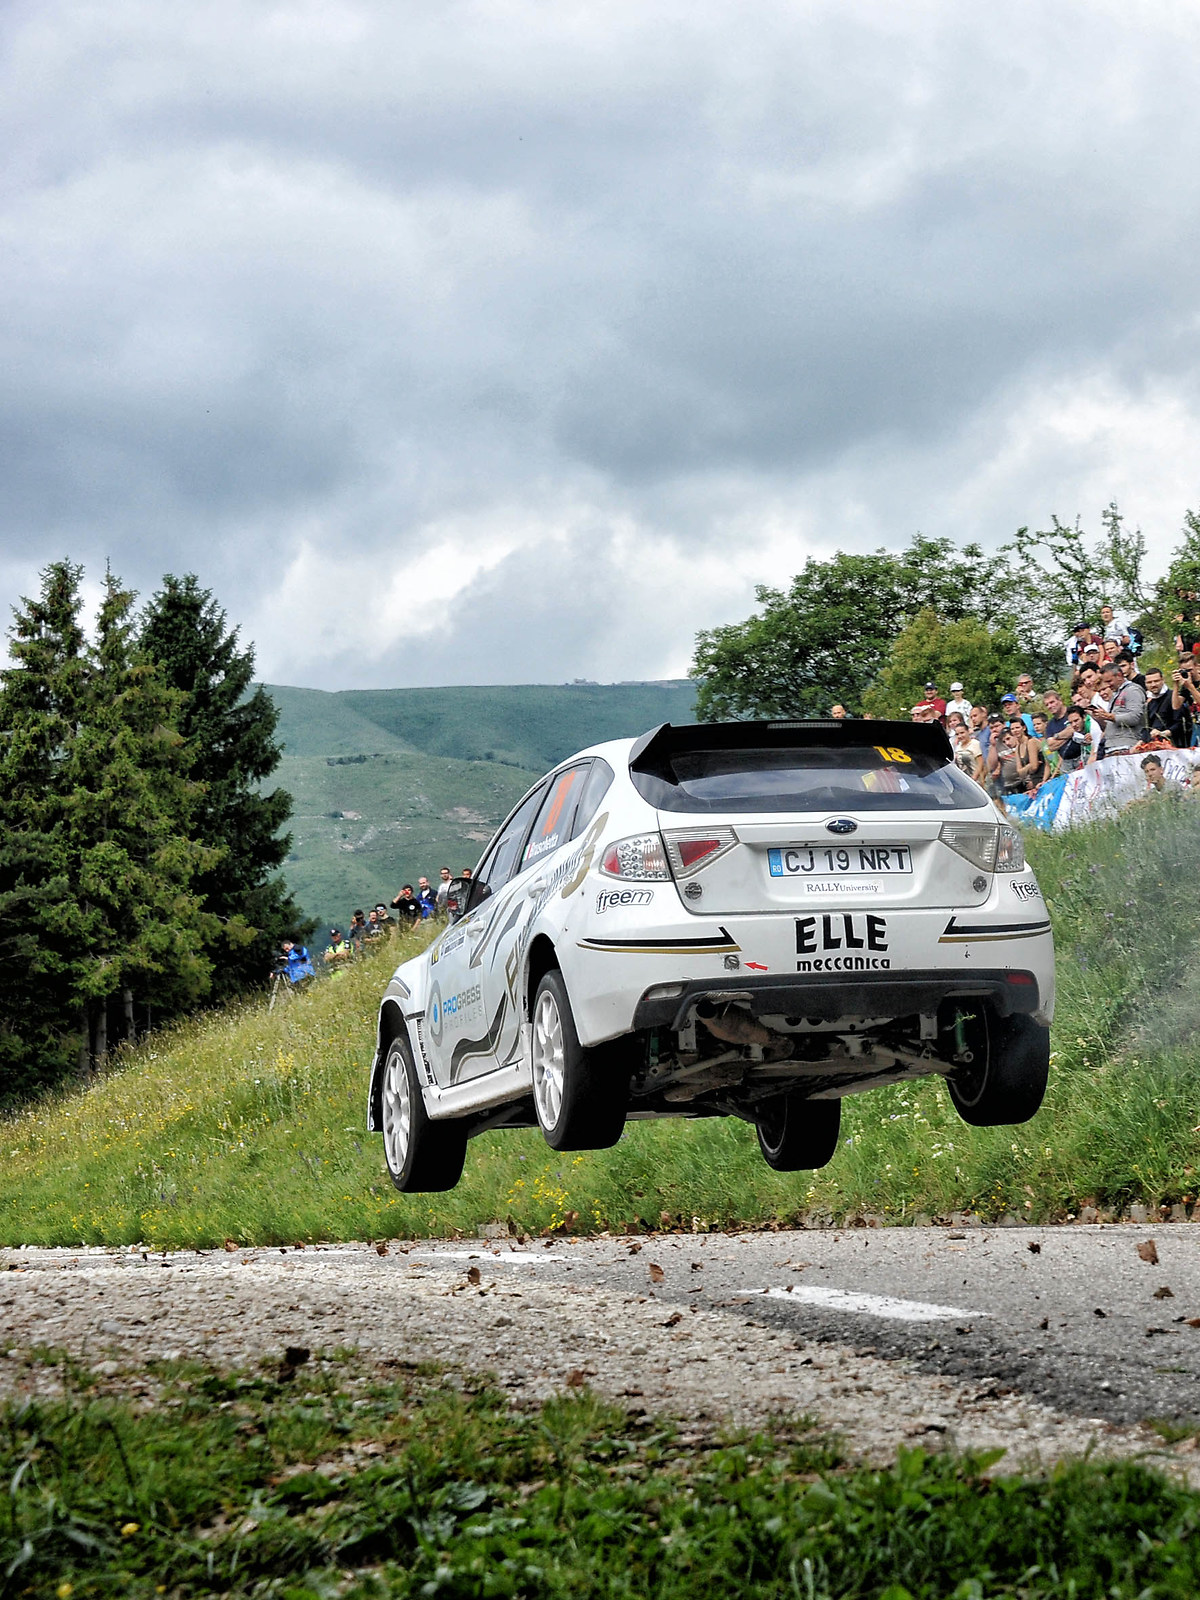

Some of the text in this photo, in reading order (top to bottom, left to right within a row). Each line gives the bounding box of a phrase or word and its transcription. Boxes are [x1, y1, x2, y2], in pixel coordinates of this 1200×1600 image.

[872, 745, 912, 763] 18
[772, 864, 782, 874] RO
[785, 847, 909, 872] CJ 19 NRT
[598, 890, 652, 911] freem
[795, 914, 889, 954] ELLE
[796, 956, 890, 972] meccanica
[442, 984, 481, 1017] PROGRESS
